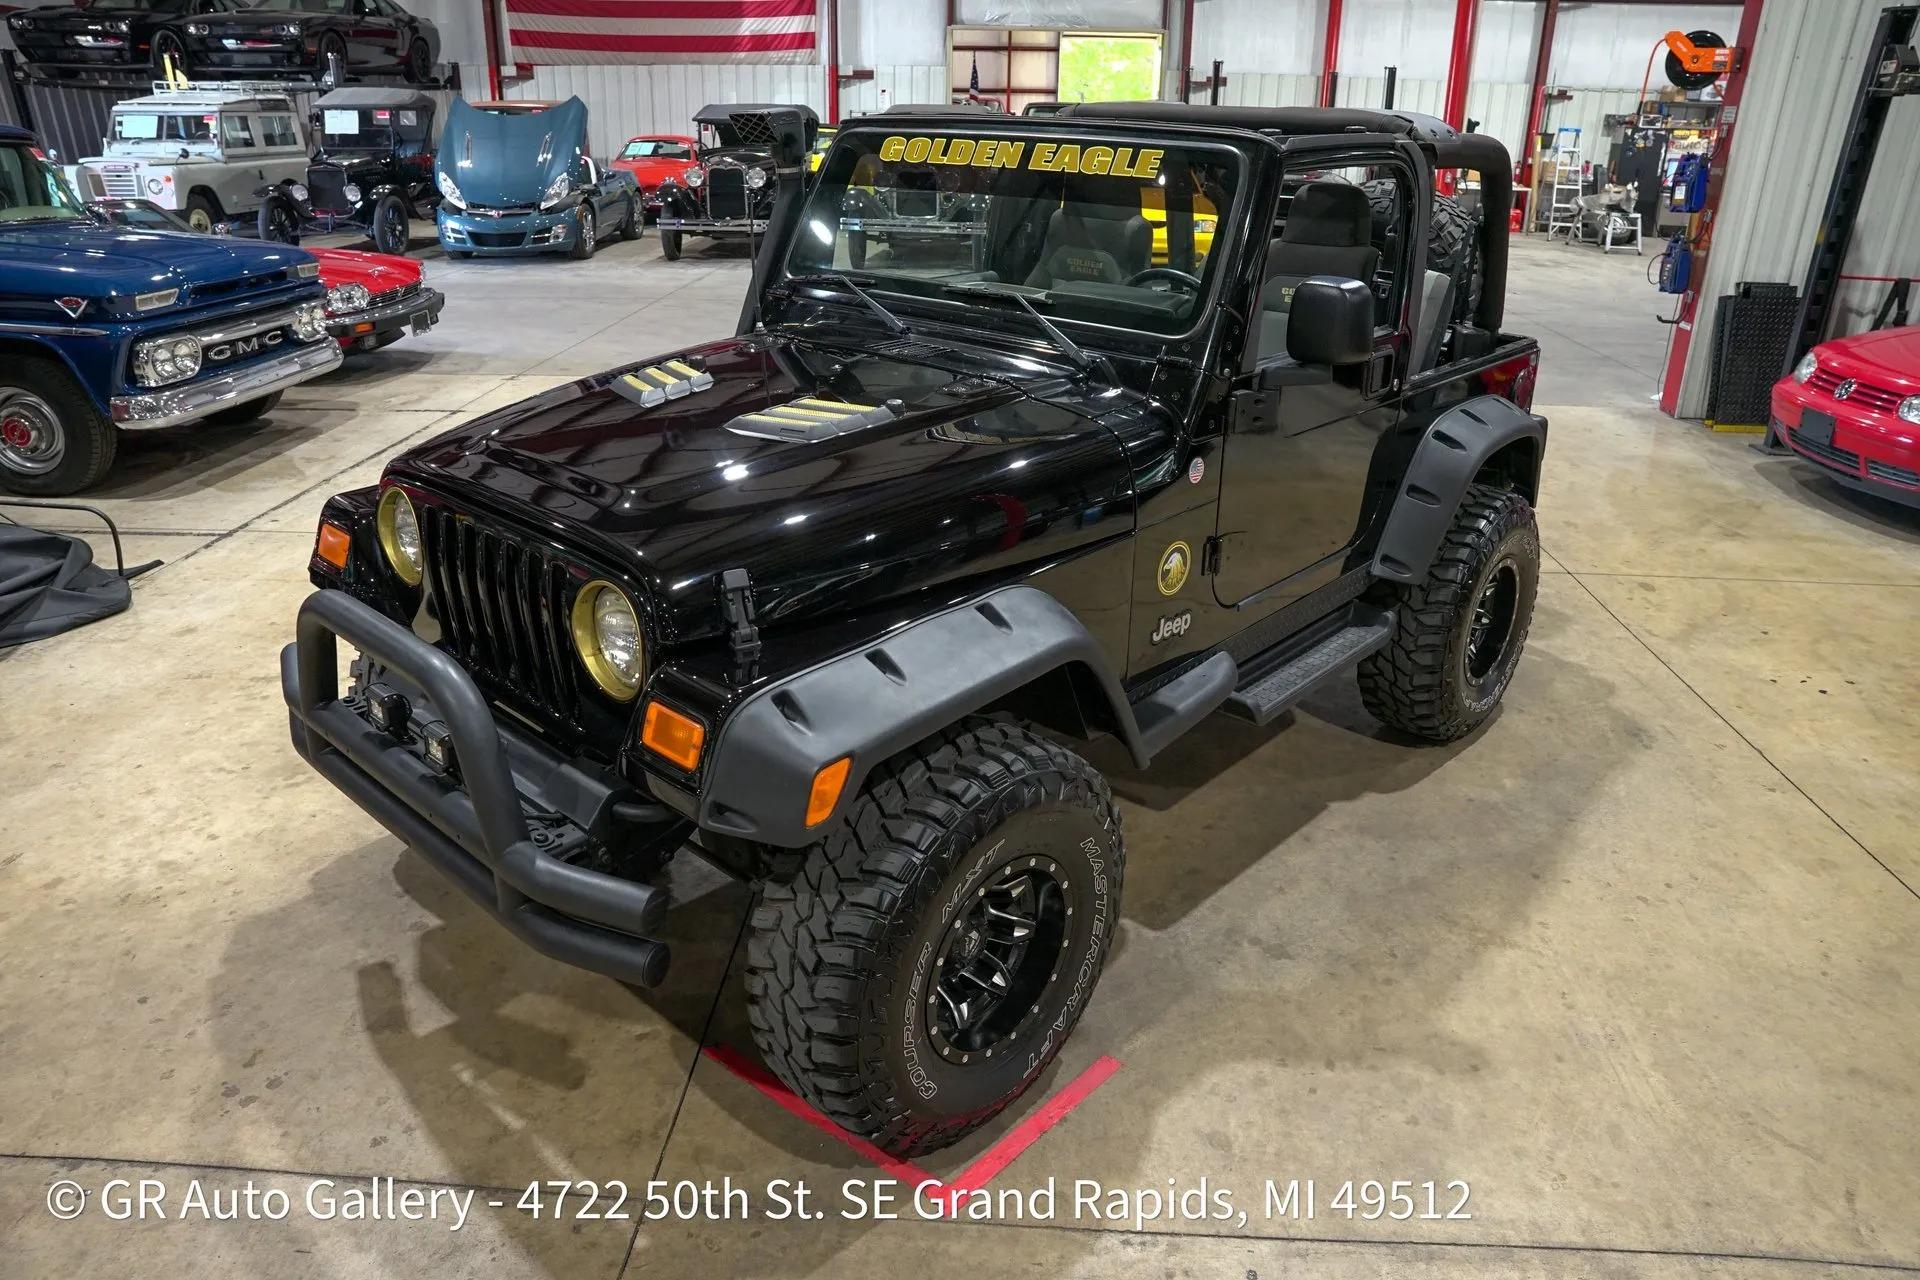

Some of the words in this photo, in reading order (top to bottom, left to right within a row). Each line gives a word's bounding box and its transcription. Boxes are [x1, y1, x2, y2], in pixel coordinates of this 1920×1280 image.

[879, 136, 1025, 169] GOLDEN
[1028, 143, 1164, 179] EAGLE
[208, 330, 283, 361] GMC
[1152, 612, 1192, 643] Jeep
[903, 941, 937, 1100] COURSER
[942, 838, 1006, 924] MXT
[1023, 837, 1108, 1080] MASTERCRAFT
